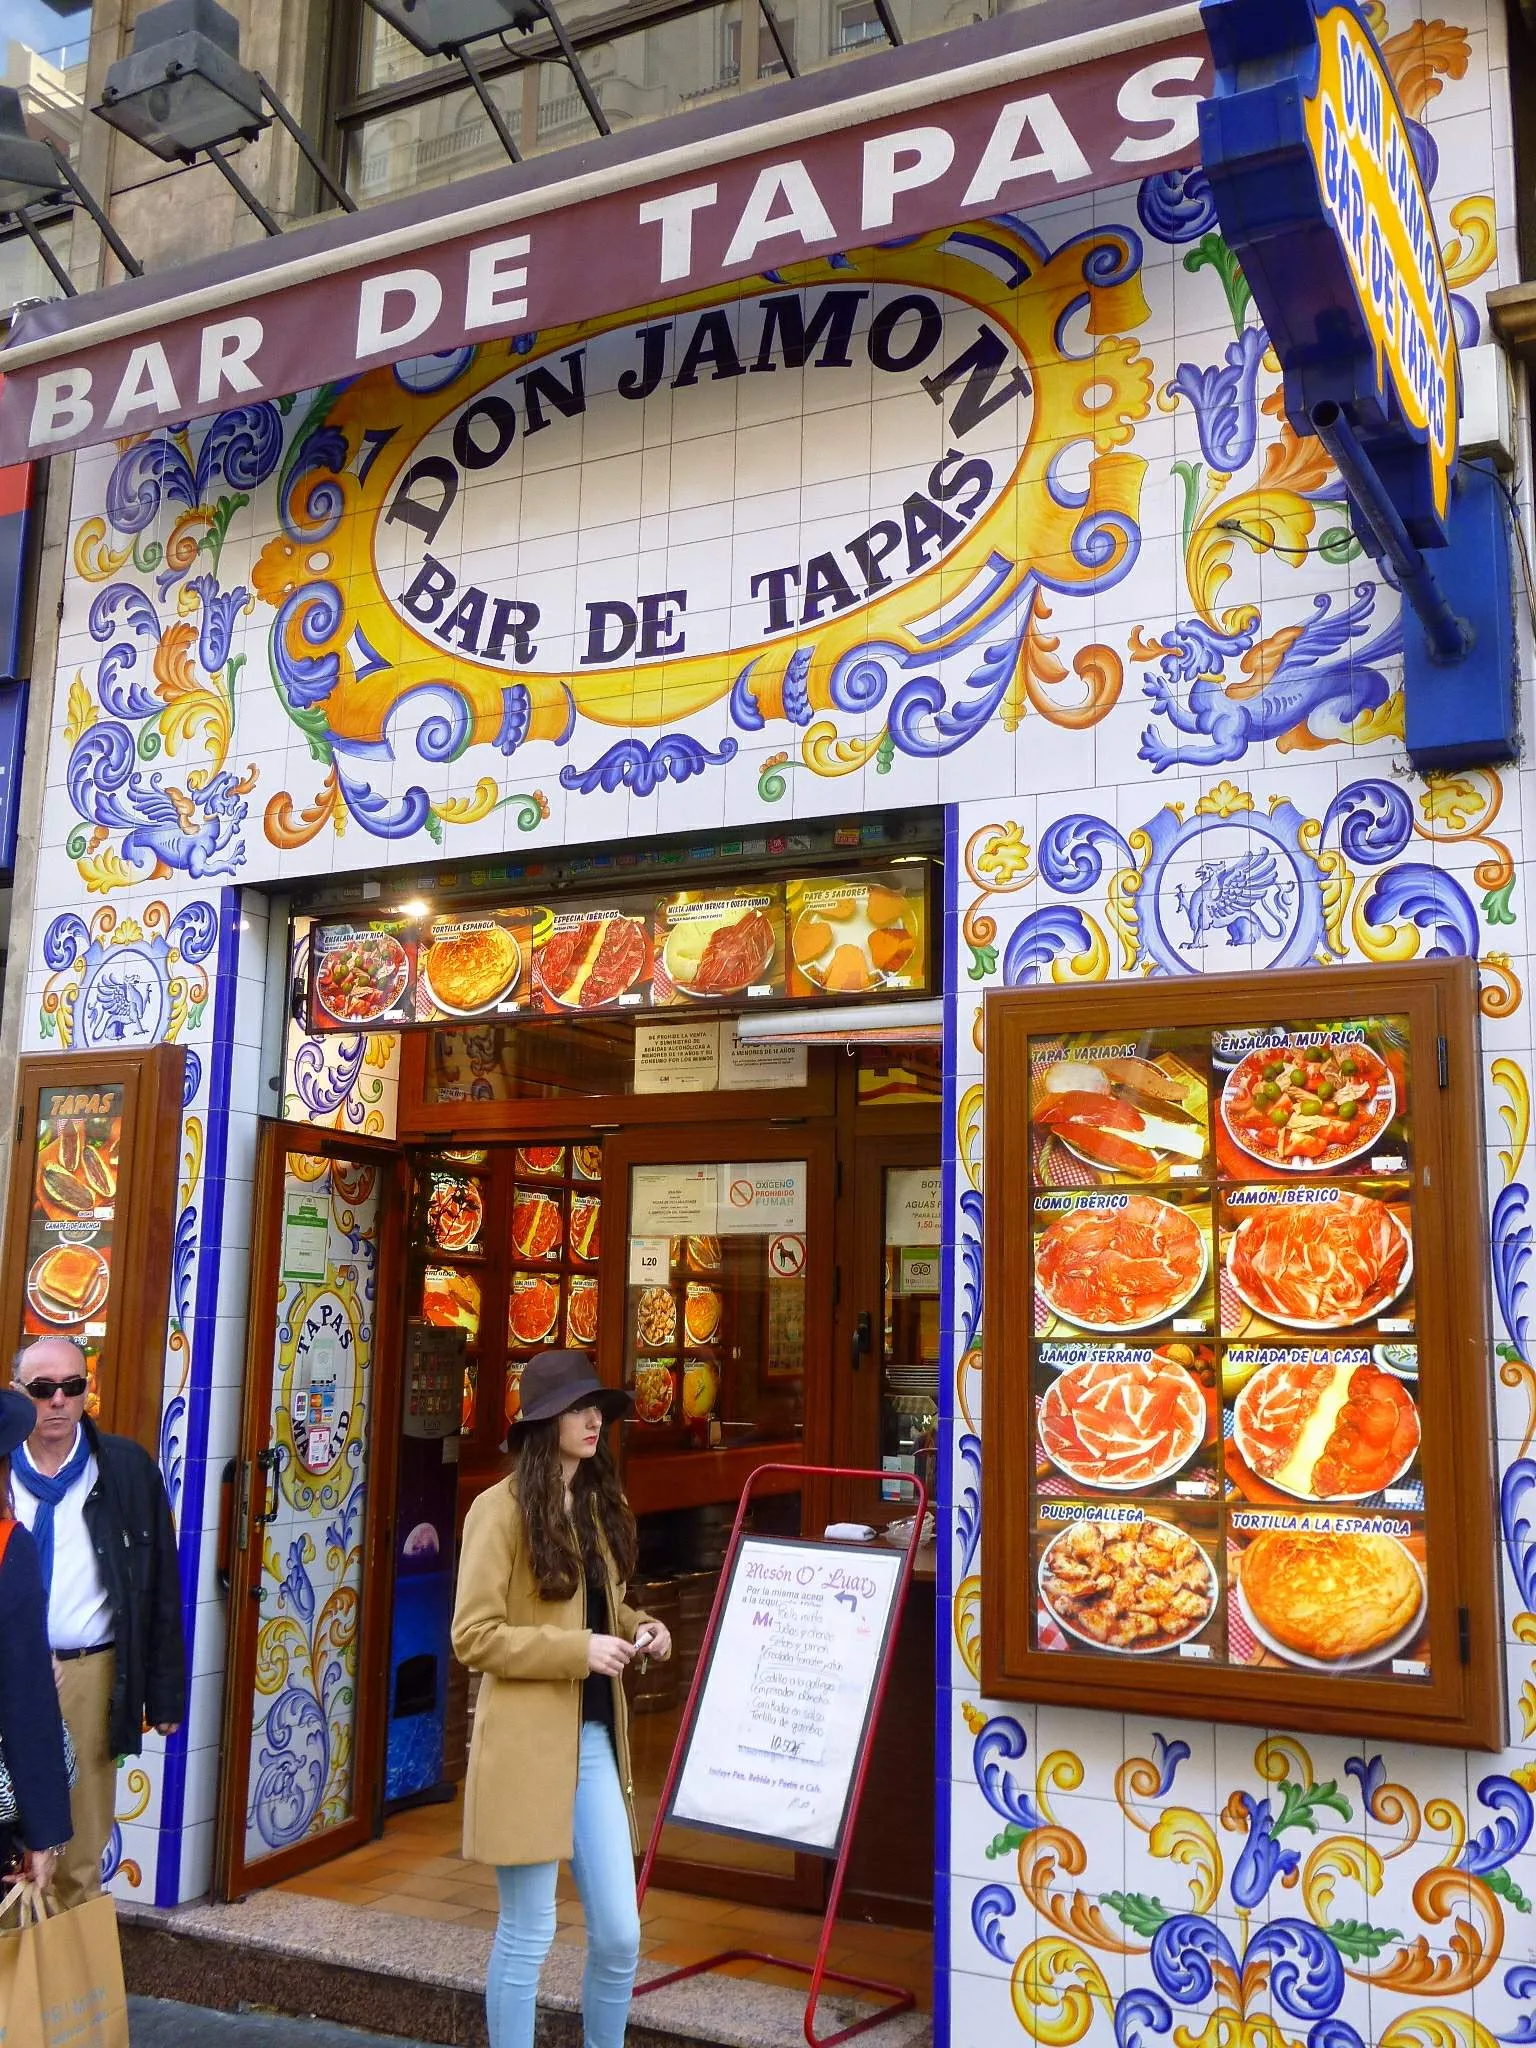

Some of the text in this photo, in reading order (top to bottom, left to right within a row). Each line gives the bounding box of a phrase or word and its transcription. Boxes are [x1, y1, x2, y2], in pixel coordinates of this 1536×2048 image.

[1340, 34, 1448, 355] DON JAMON
[28, 57, 1204, 448] BAR DE TAPAS
[1324, 103, 1445, 447] BAR DE TAPAS
[384, 285, 1032, 544] DON JAMON
[398, 448, 993, 664] BAR DE TAPAS
[832, 888, 867, 898] SABORES
[554, 914, 584, 924] ESPECIAL
[432, 923, 461, 934] TORTILLA
[325, 935, 354, 944] ENSALADA
[355, 933, 369, 941] MUY
[1296, 1033, 1328, 1046] MUY
[1331, 1030, 1364, 1043] RICA
[1033, 1044, 1136, 1062] TAPAS VARIADAS
[51, 1093, 114, 1115] TAPAS
[756, 1190, 794, 1198] PROHIBIDO
[1035, 1193, 1128, 1209] LOMO IBÉRICO
[1229, 1187, 1338, 1204] JAMÓN IBÉRICO
[756, 1198, 794, 1207] FUMAR
[905, 1200, 935, 1209] AGUAS
[642, 1257, 658, 1266] L20
[297, 1304, 353, 1354] TAPAS
[1090, 1349, 1152, 1362] SERRANO
[1229, 1350, 1369, 1363] VARIADA DE LA CASA
[1041, 1505, 1143, 1521] PULPO GALLEGA
[1233, 1514, 1297, 1529] TORTILLA
[1301, 1518, 1310, 1530] A
[1315, 1518, 1330, 1530] LA
